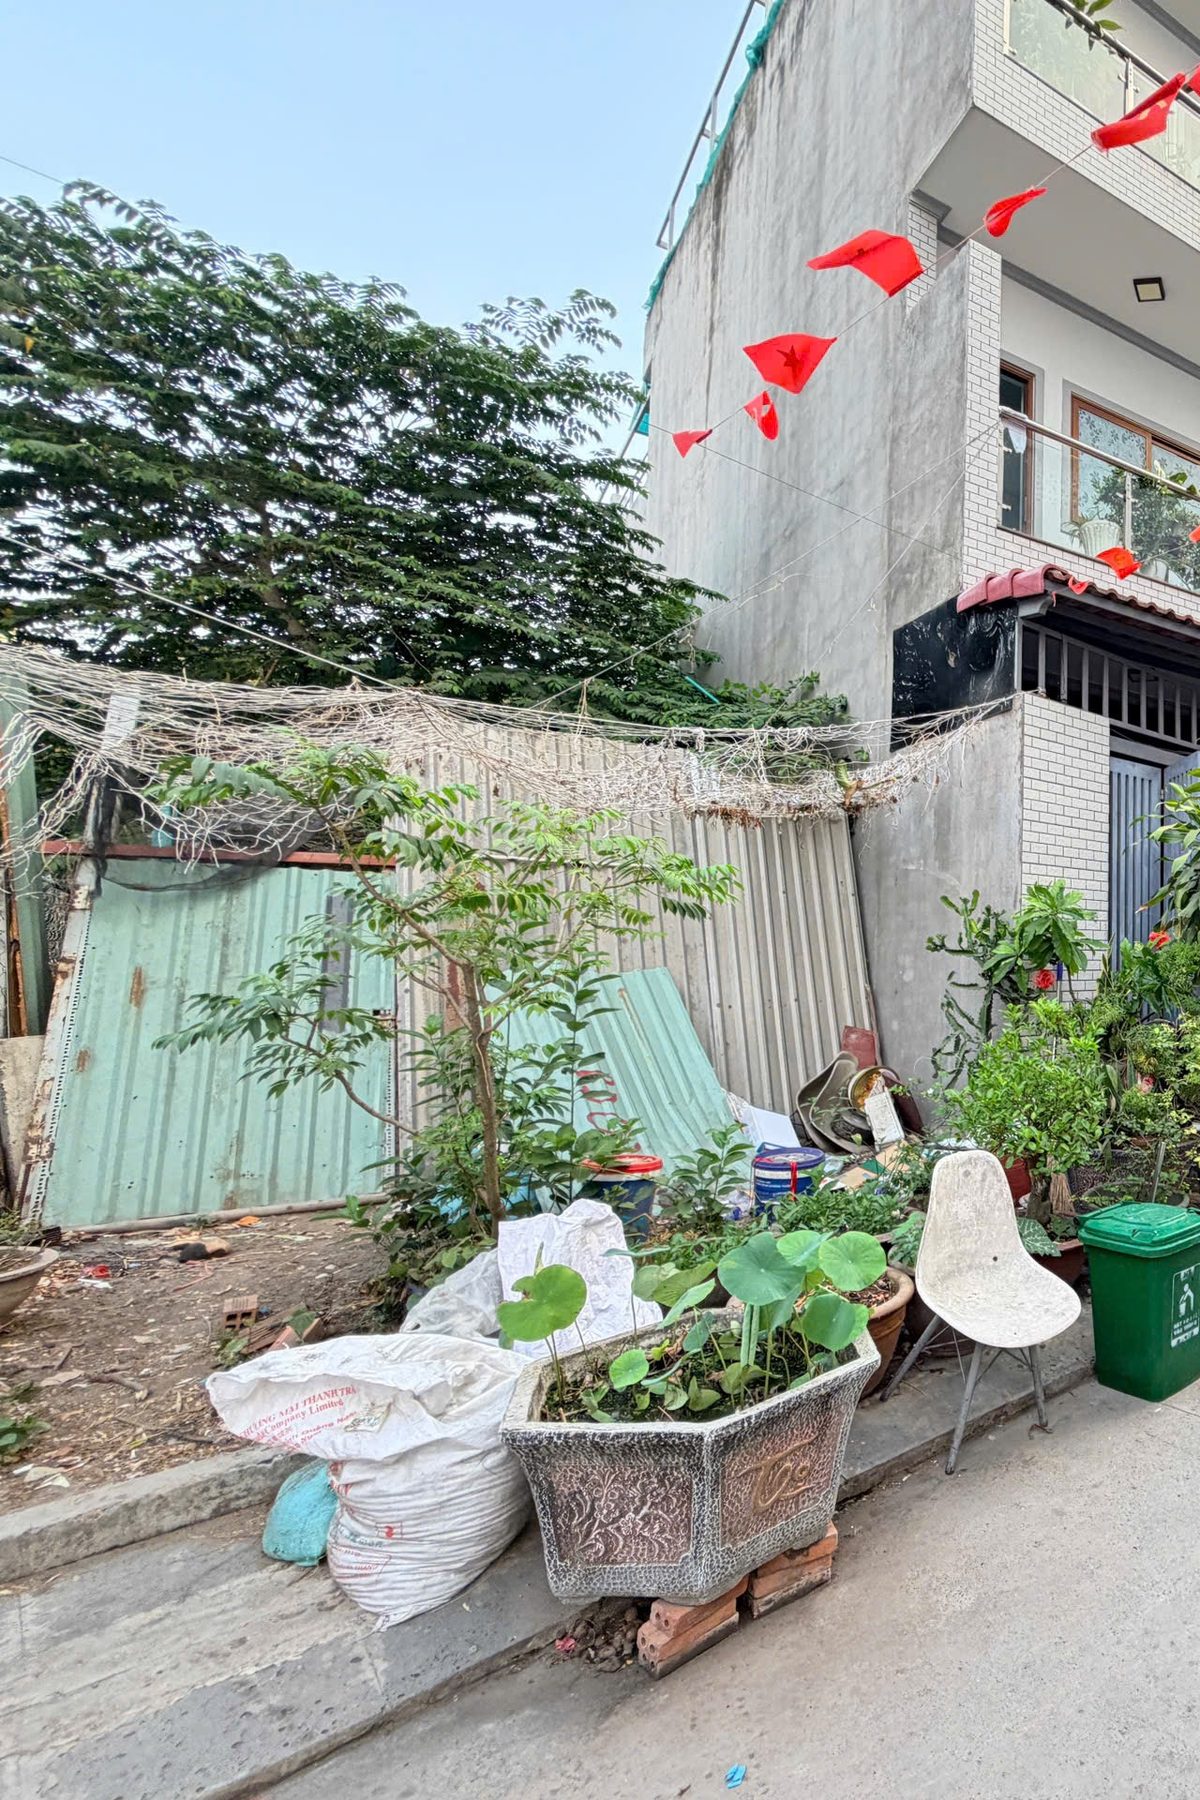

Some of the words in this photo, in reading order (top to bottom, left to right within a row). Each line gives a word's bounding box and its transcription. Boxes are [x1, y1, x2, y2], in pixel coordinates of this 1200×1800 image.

[302, 1388, 339, 1407] THANH
[263, 1410, 307, 1437] Company
[308, 1399, 345, 1416] Limited
